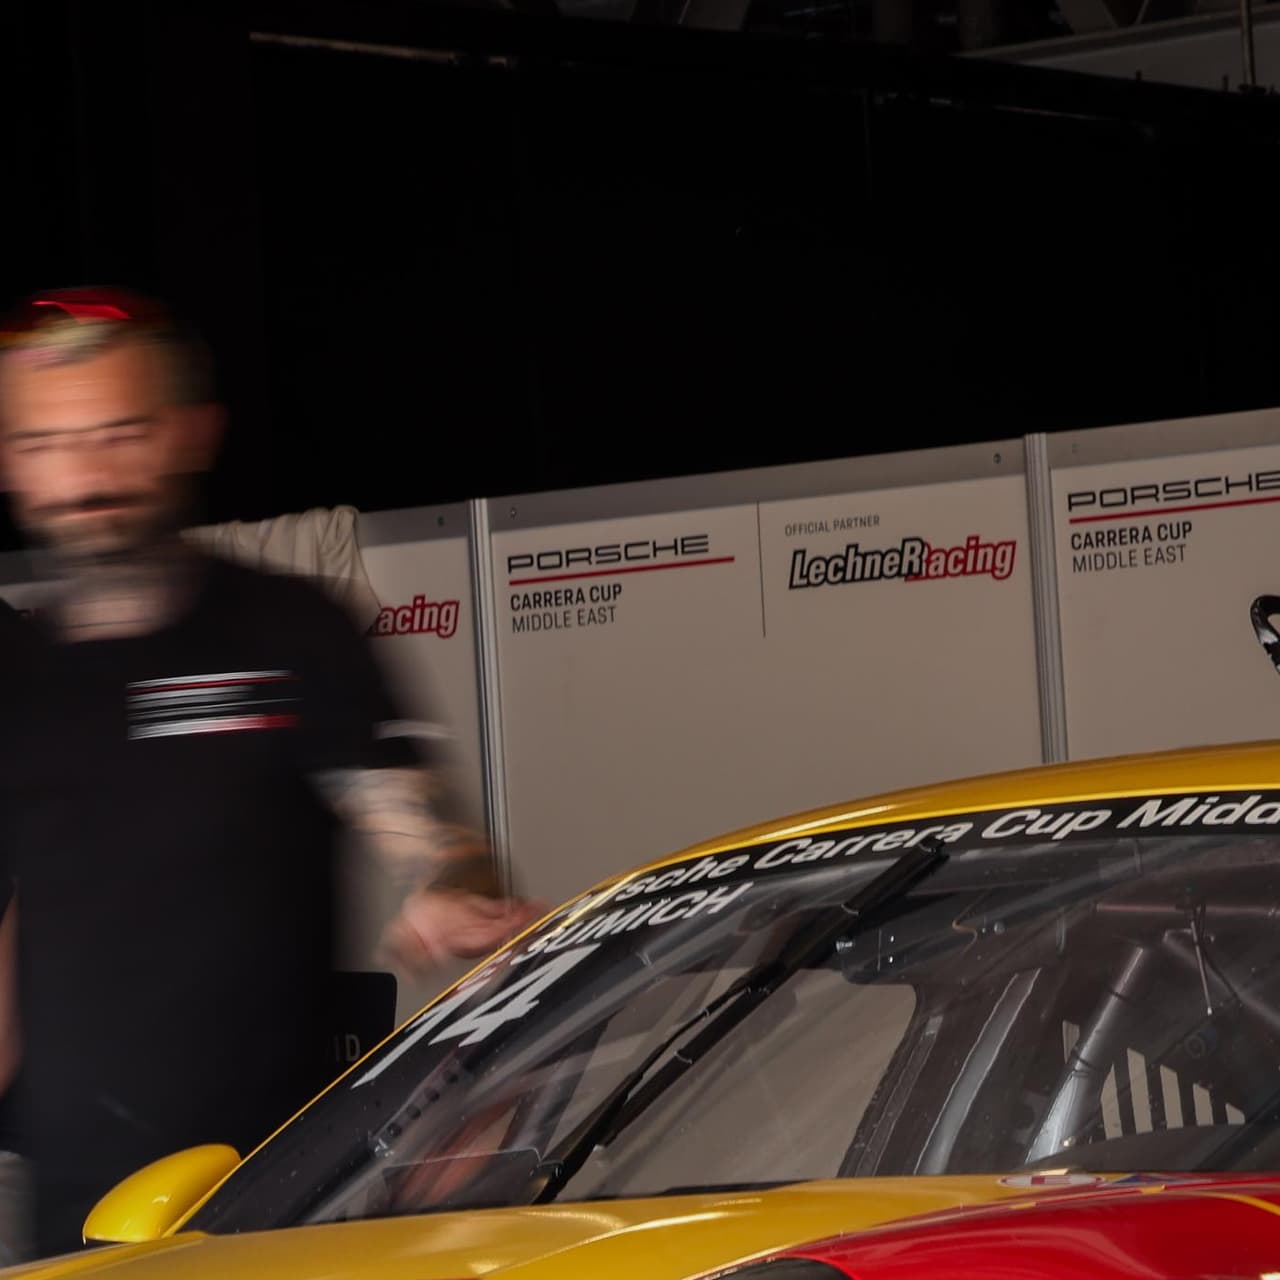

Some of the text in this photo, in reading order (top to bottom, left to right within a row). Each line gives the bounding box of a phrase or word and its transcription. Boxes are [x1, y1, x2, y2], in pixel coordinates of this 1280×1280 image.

[784, 514, 881, 536] OFFICIAL PARTNER
[1071, 521, 1193, 550] CARRERA CUP
[508, 533, 710, 574] PORSCHE
[1072, 544, 1187, 573] MIDDLE EAST
[509, 582, 623, 612] CARRERA CUP
[511, 605, 617, 634] MIDDLE EAST
[753, 819, 974, 872] Carrera
[981, 806, 1112, 841] Cup
[351, 943, 602, 1089] 14
